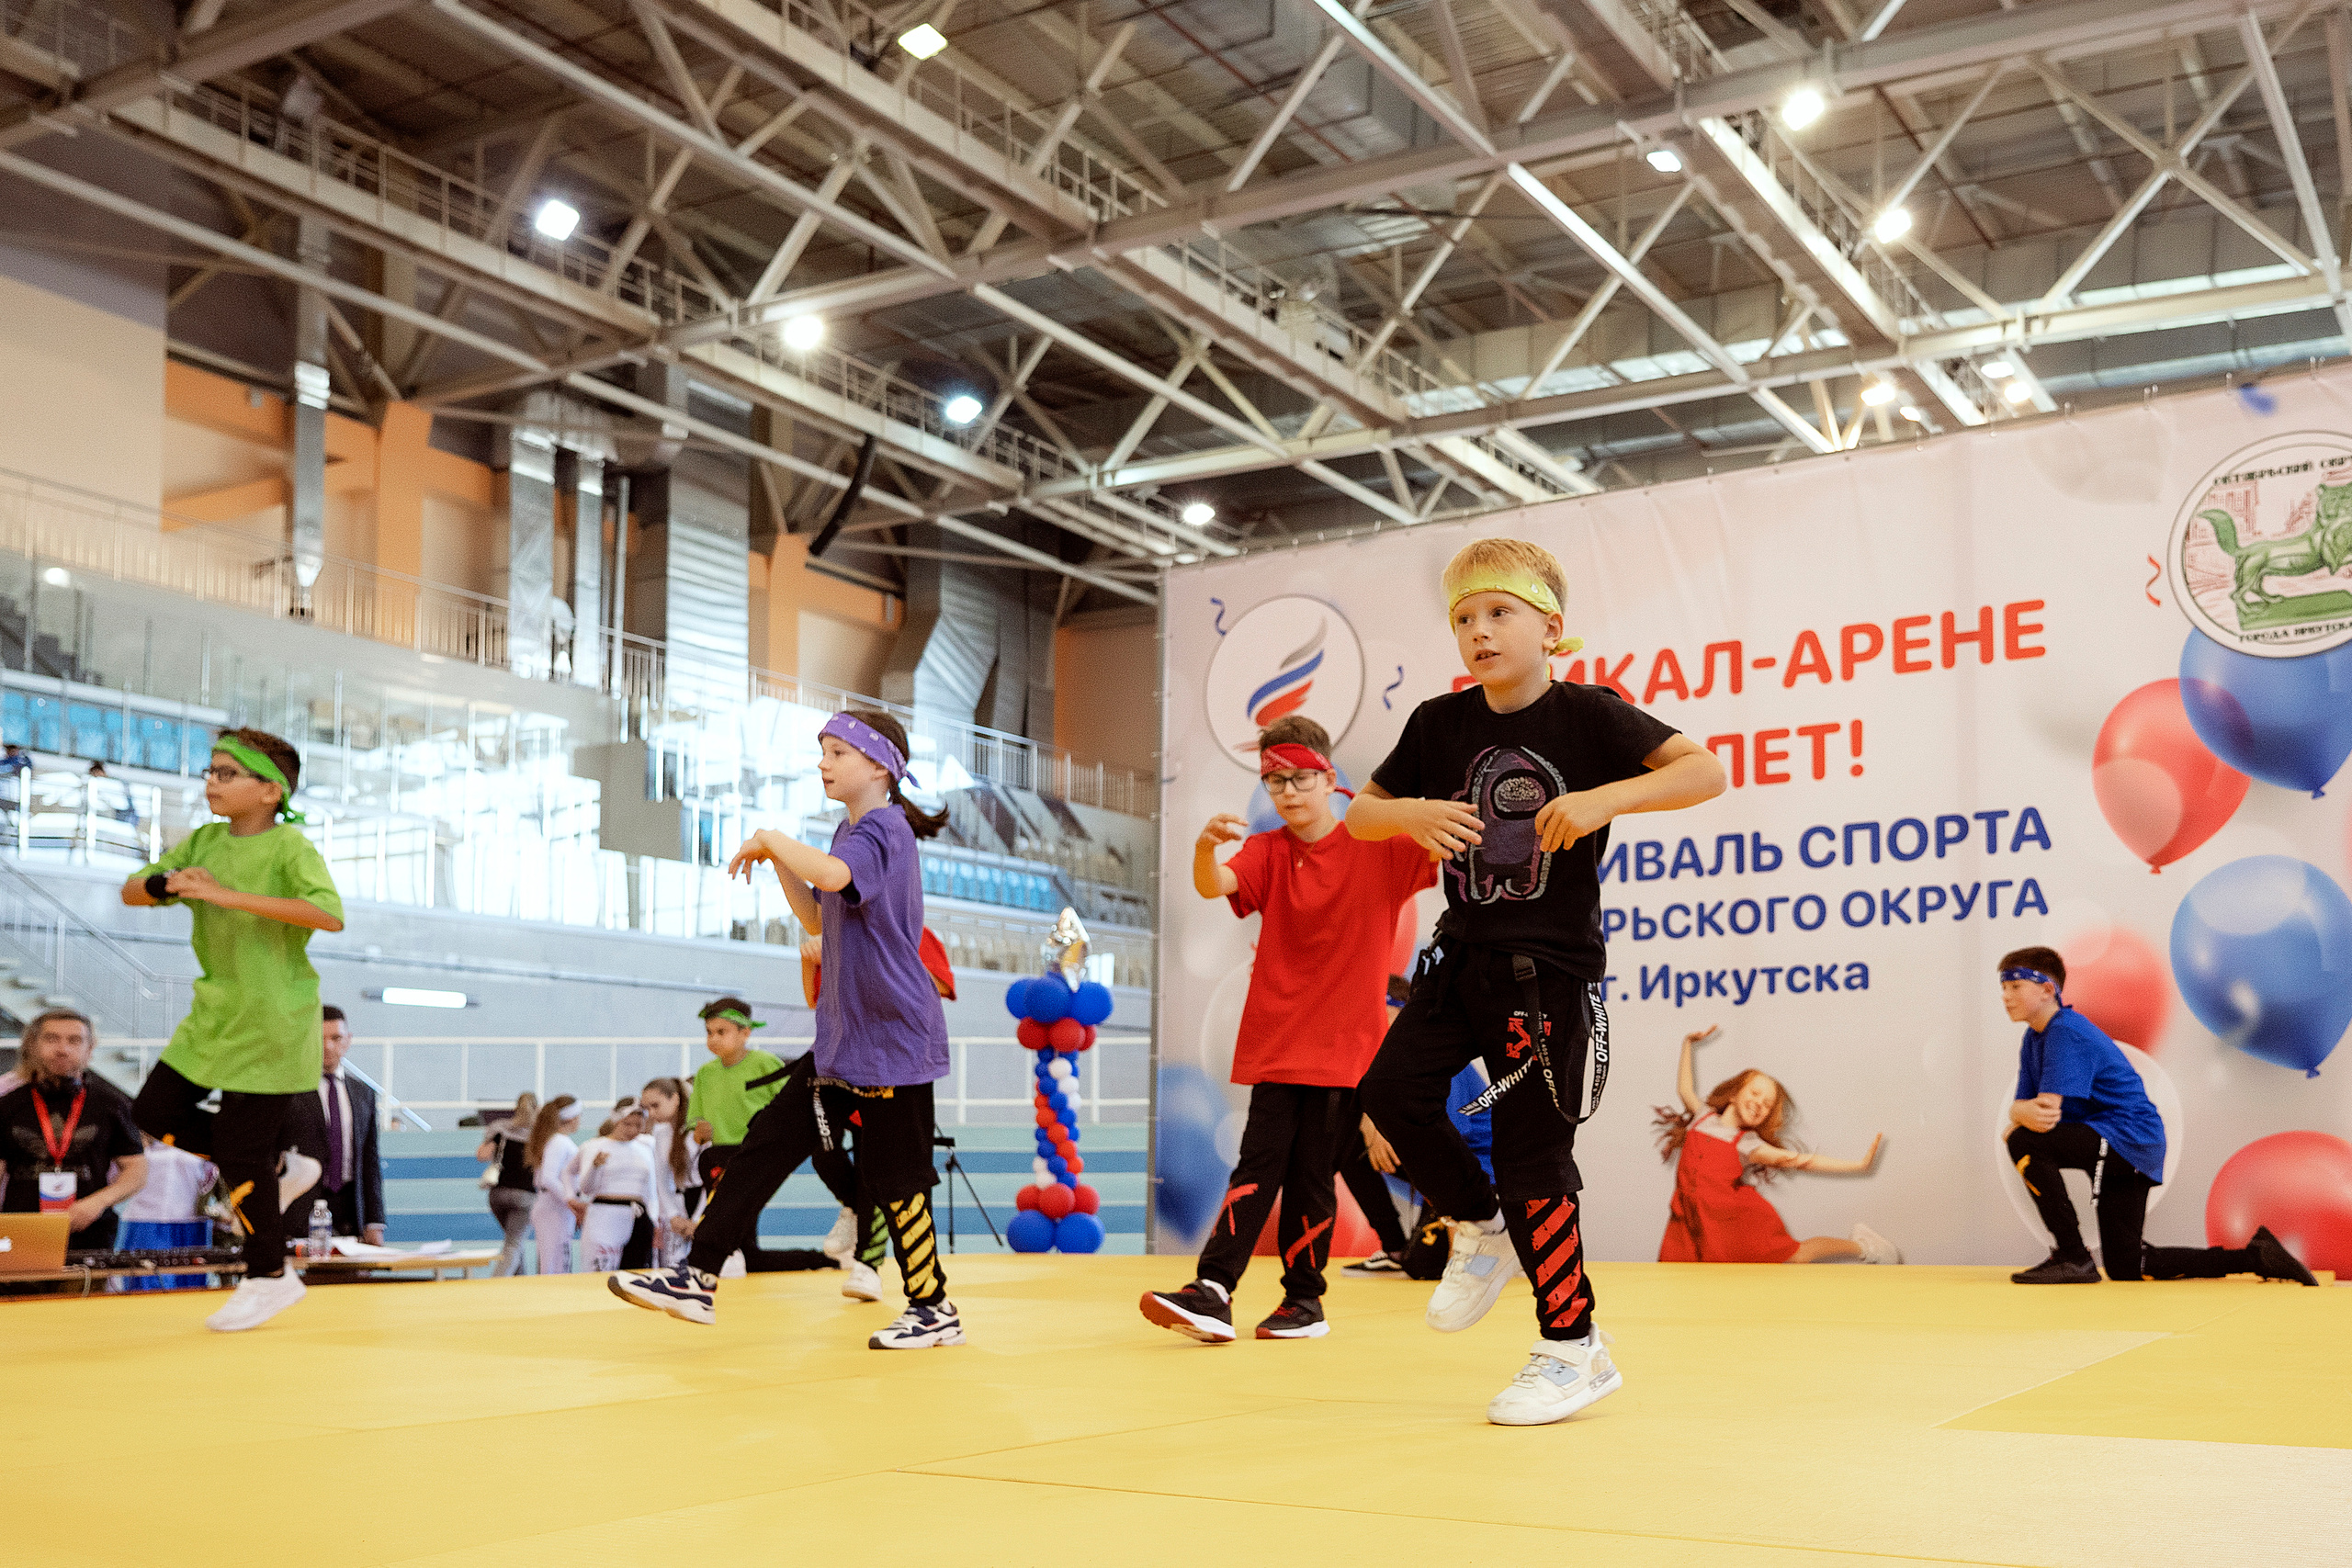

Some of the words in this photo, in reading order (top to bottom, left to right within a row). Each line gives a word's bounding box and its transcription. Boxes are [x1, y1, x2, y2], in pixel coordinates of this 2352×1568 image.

[1451, 599, 2047, 705] КАЛ-АРЕНЕ
[1597, 830, 1783, 885] ИВАЛЬ
[1798, 806, 2052, 869] СПОРТА
[1602, 893, 1827, 943] РЬСКОГО
[1839, 877, 2049, 929] ОКРУГА
[1641, 961, 1871, 1008] Иркутска
[1589, 992, 1609, 1063] OFF-WHITE
